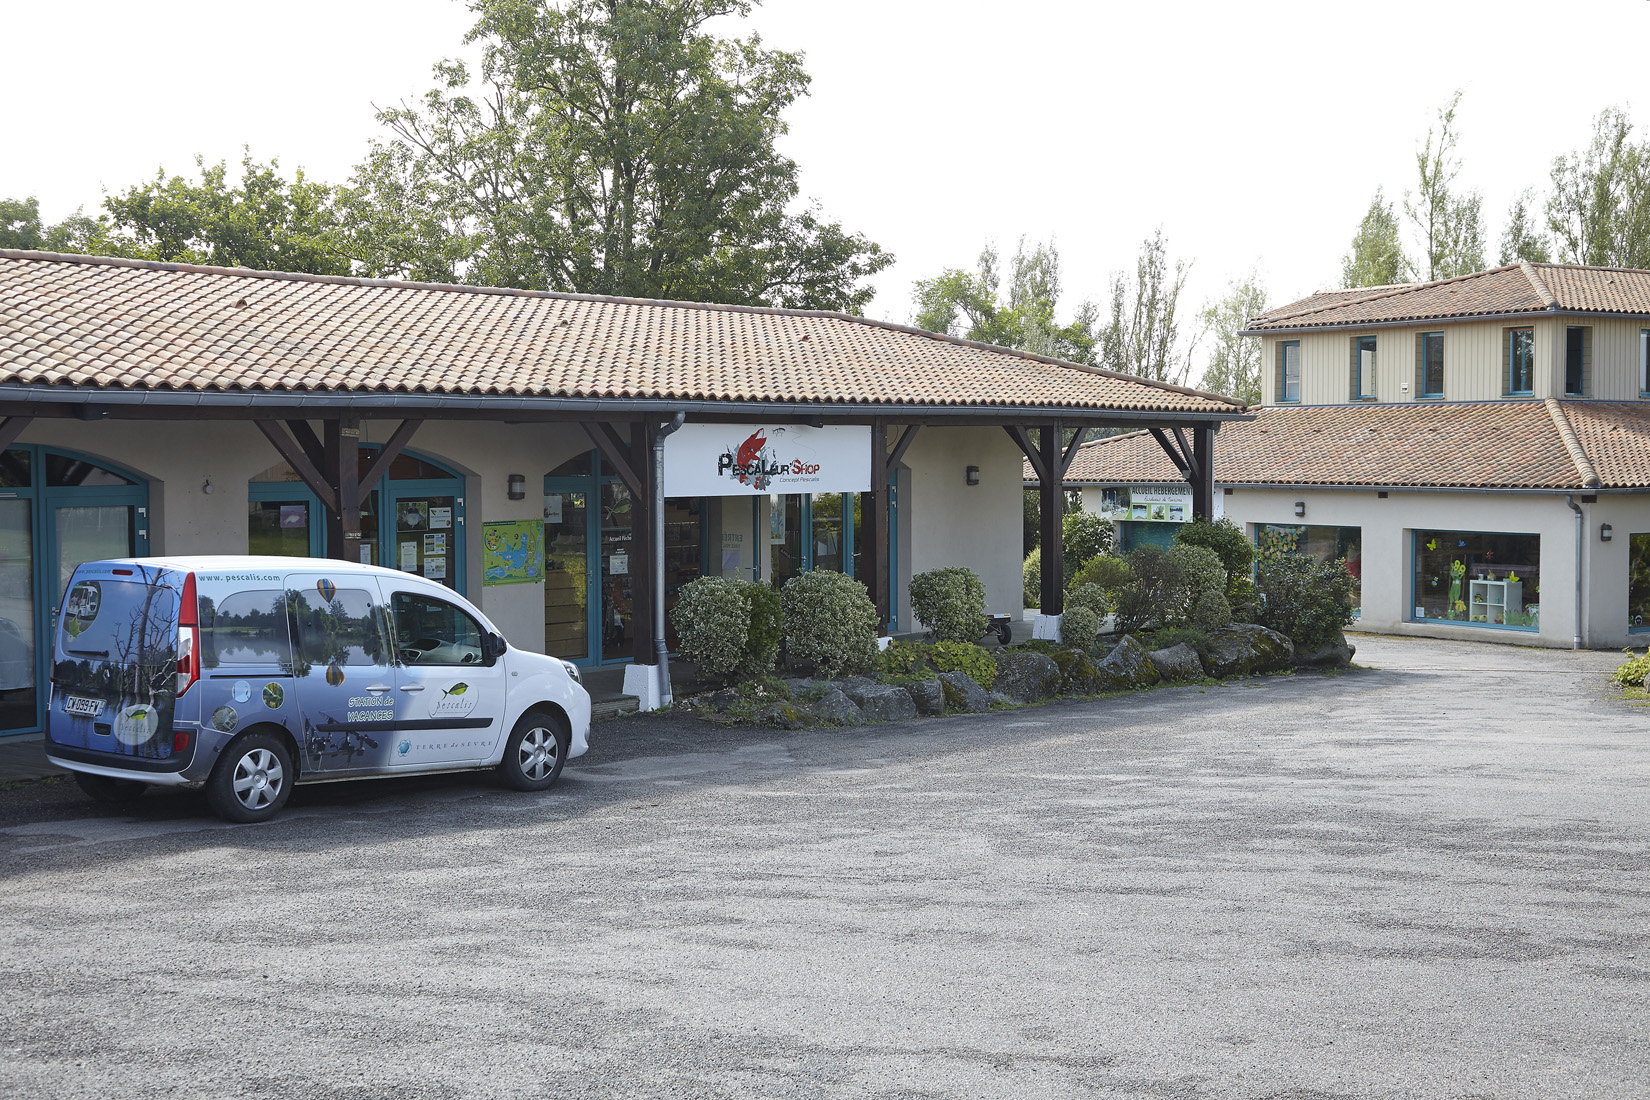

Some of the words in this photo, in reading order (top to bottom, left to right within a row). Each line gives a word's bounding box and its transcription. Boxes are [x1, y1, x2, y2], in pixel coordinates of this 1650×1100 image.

[1132, 486, 1153, 495] ACCUEIL
[348, 696, 383, 708] STATION
[384, 695, 394, 707] de
[347, 709, 394, 722] VACANCES
